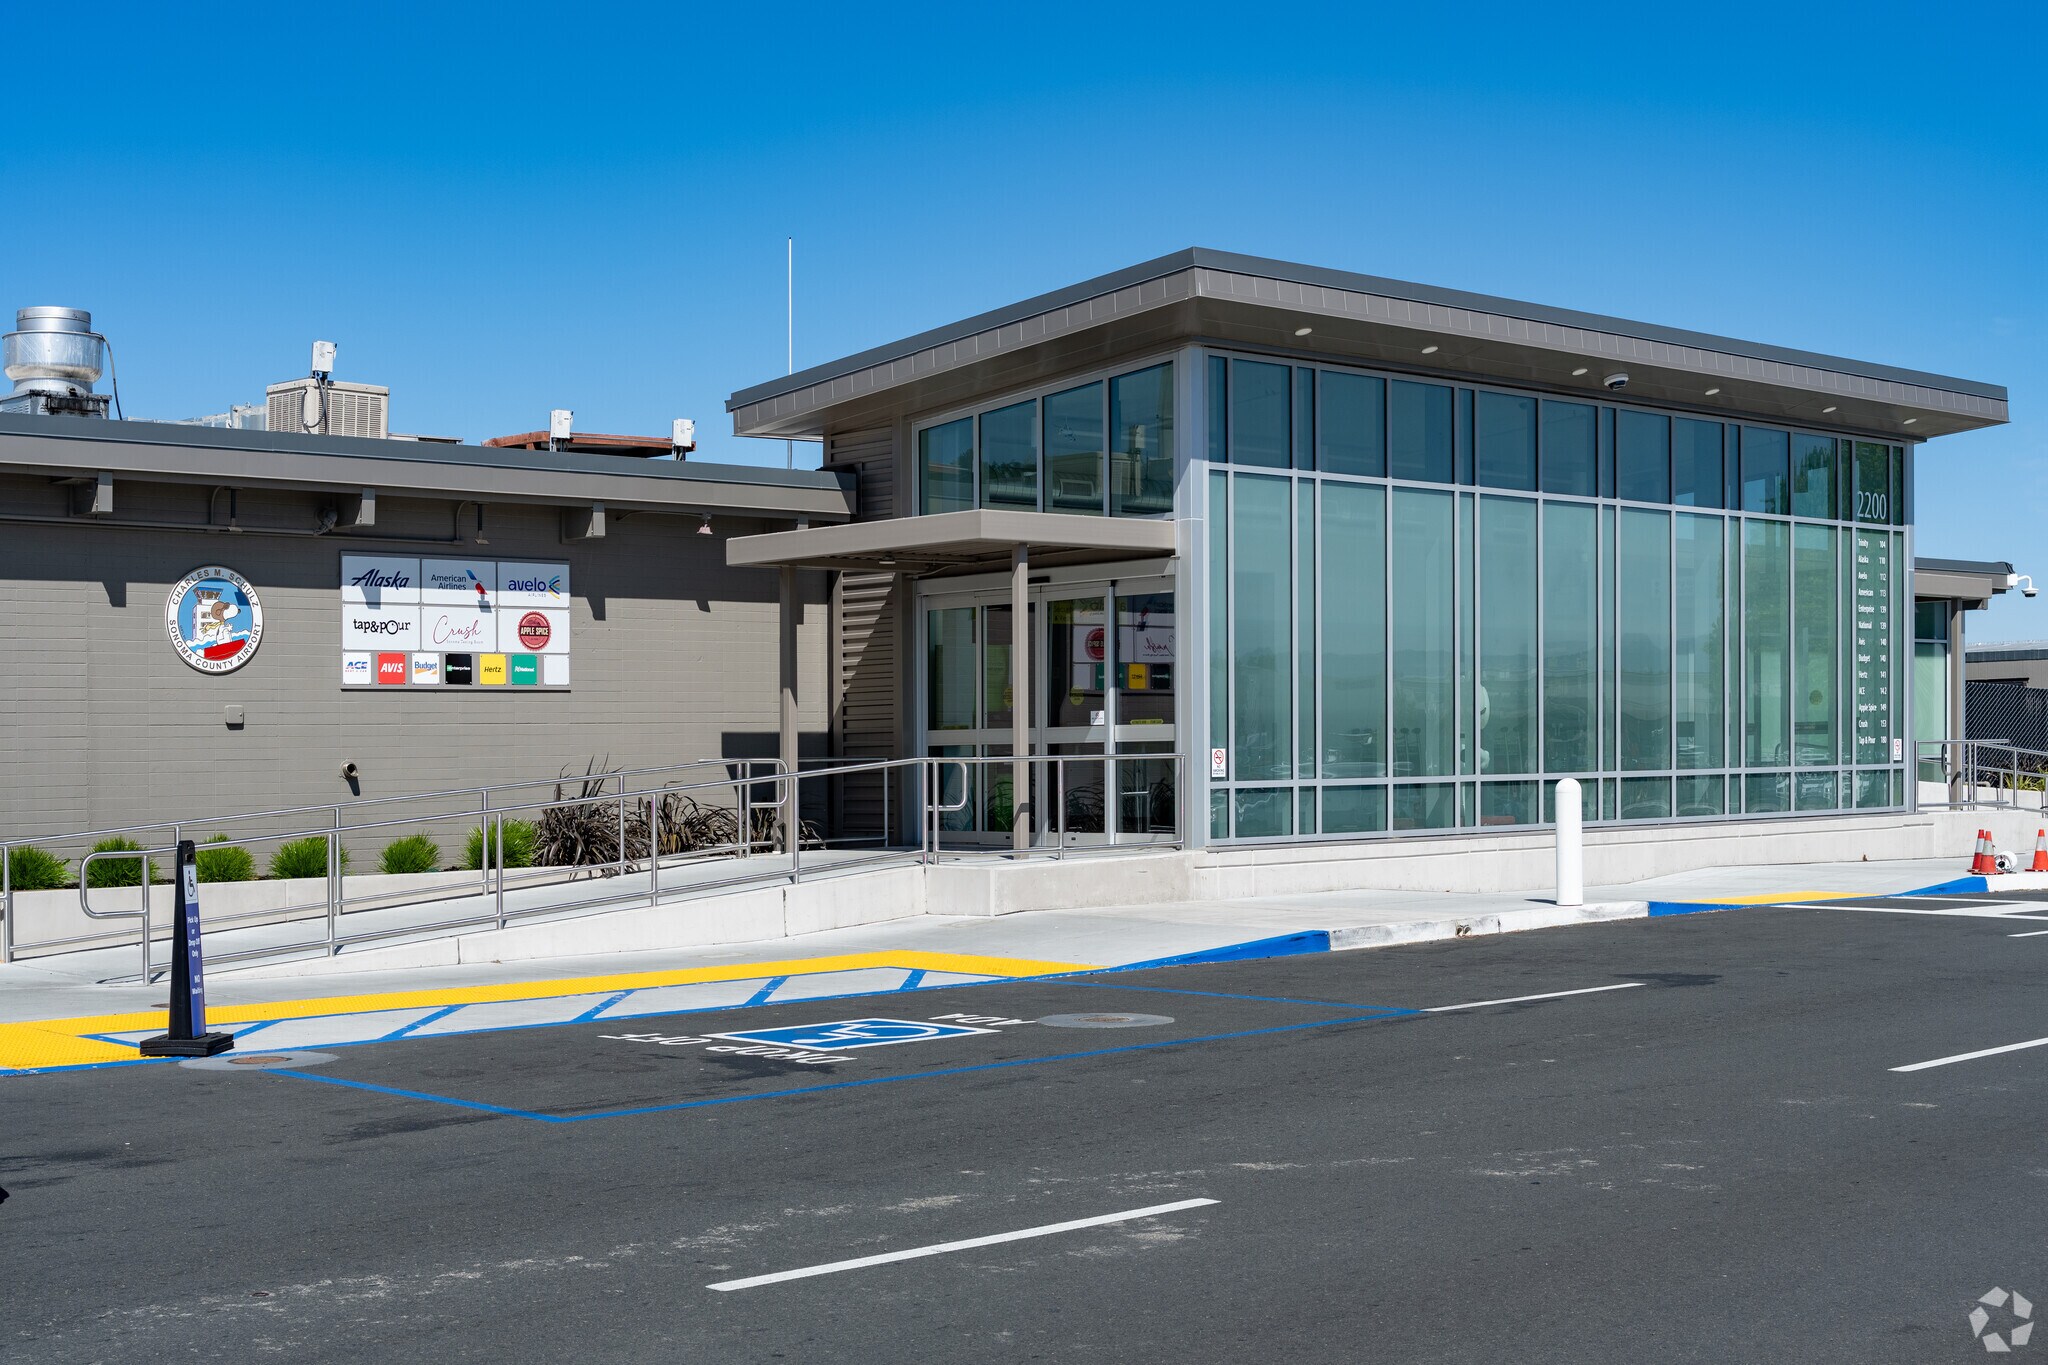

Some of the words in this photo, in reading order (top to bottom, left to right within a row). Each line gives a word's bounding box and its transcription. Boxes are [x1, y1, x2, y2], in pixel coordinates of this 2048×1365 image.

[1857, 490, 1886, 519] 2200
[1858, 538, 1868, 549] Trinity
[1858, 555, 1869, 564] Alaska
[351, 568, 410, 590] Alaska
[431, 574, 467, 583] American
[1858, 571, 1867, 580] Avelo
[172, 569, 209, 605] CHARLES
[214, 568, 225, 578] M.
[229, 572, 259, 608] SCHULZ
[438, 582, 467, 590] Airlines
[508, 577, 546, 591] avelo
[1858, 588, 1873, 597] American
[1858, 604, 1874, 614] Enterprise
[432, 614, 482, 644] Crush
[1858, 621, 1872, 629] National
[520, 626, 535, 635] APPLE
[535, 627, 549, 636] SPICE
[169, 620, 192, 661] SONOMA
[195, 659, 234, 670] COUNTY
[236, 623, 261, 663] AIRPORT
[1858, 637, 1866, 646] Avis
[345, 661, 368, 669] ACE
[380, 662, 404, 673] AVIS
[414, 661, 437, 671] Budget
[928, 1013, 1037, 1026] ADA
[597, 1033, 712, 1045] OFF
[705, 1045, 857, 1064] DROP
